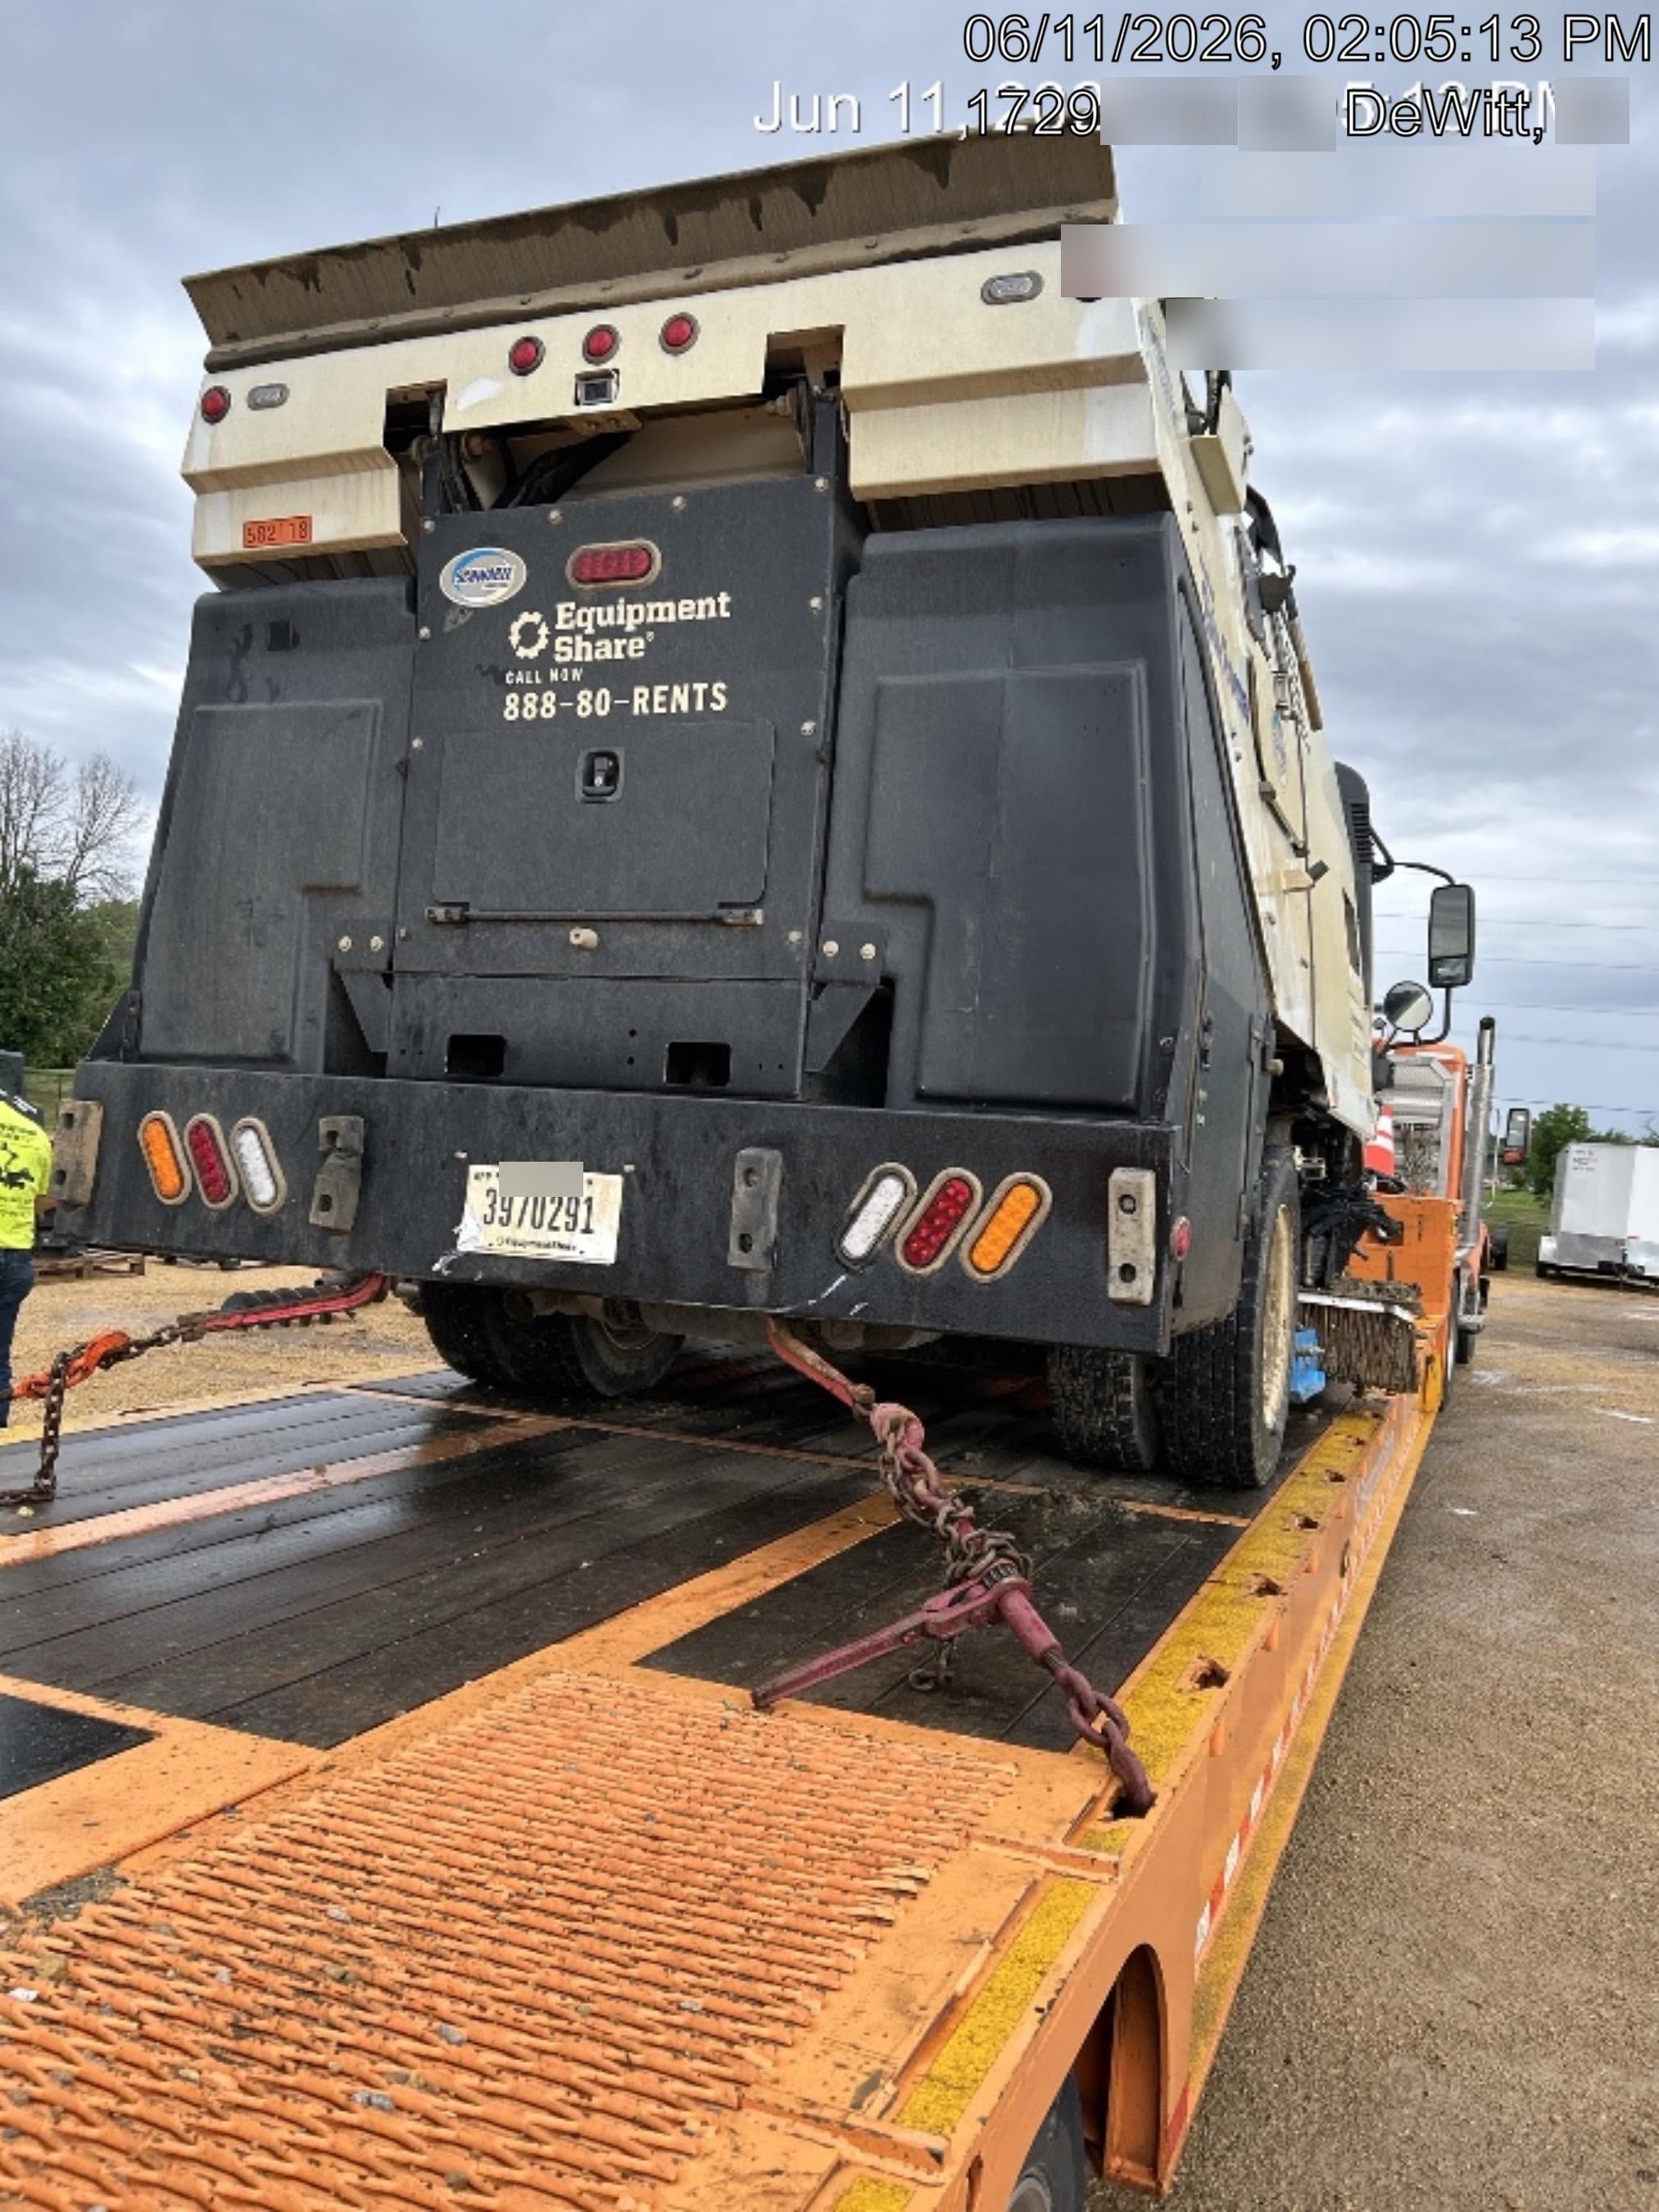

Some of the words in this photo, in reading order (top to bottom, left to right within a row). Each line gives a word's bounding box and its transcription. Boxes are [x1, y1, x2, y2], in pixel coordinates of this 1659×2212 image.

[555, 591, 732, 635] Equipment
[505, 669, 542, 685] CALL
[549, 667, 583, 682] NOW
[502, 681, 729, 721] 888-80-RENTS
